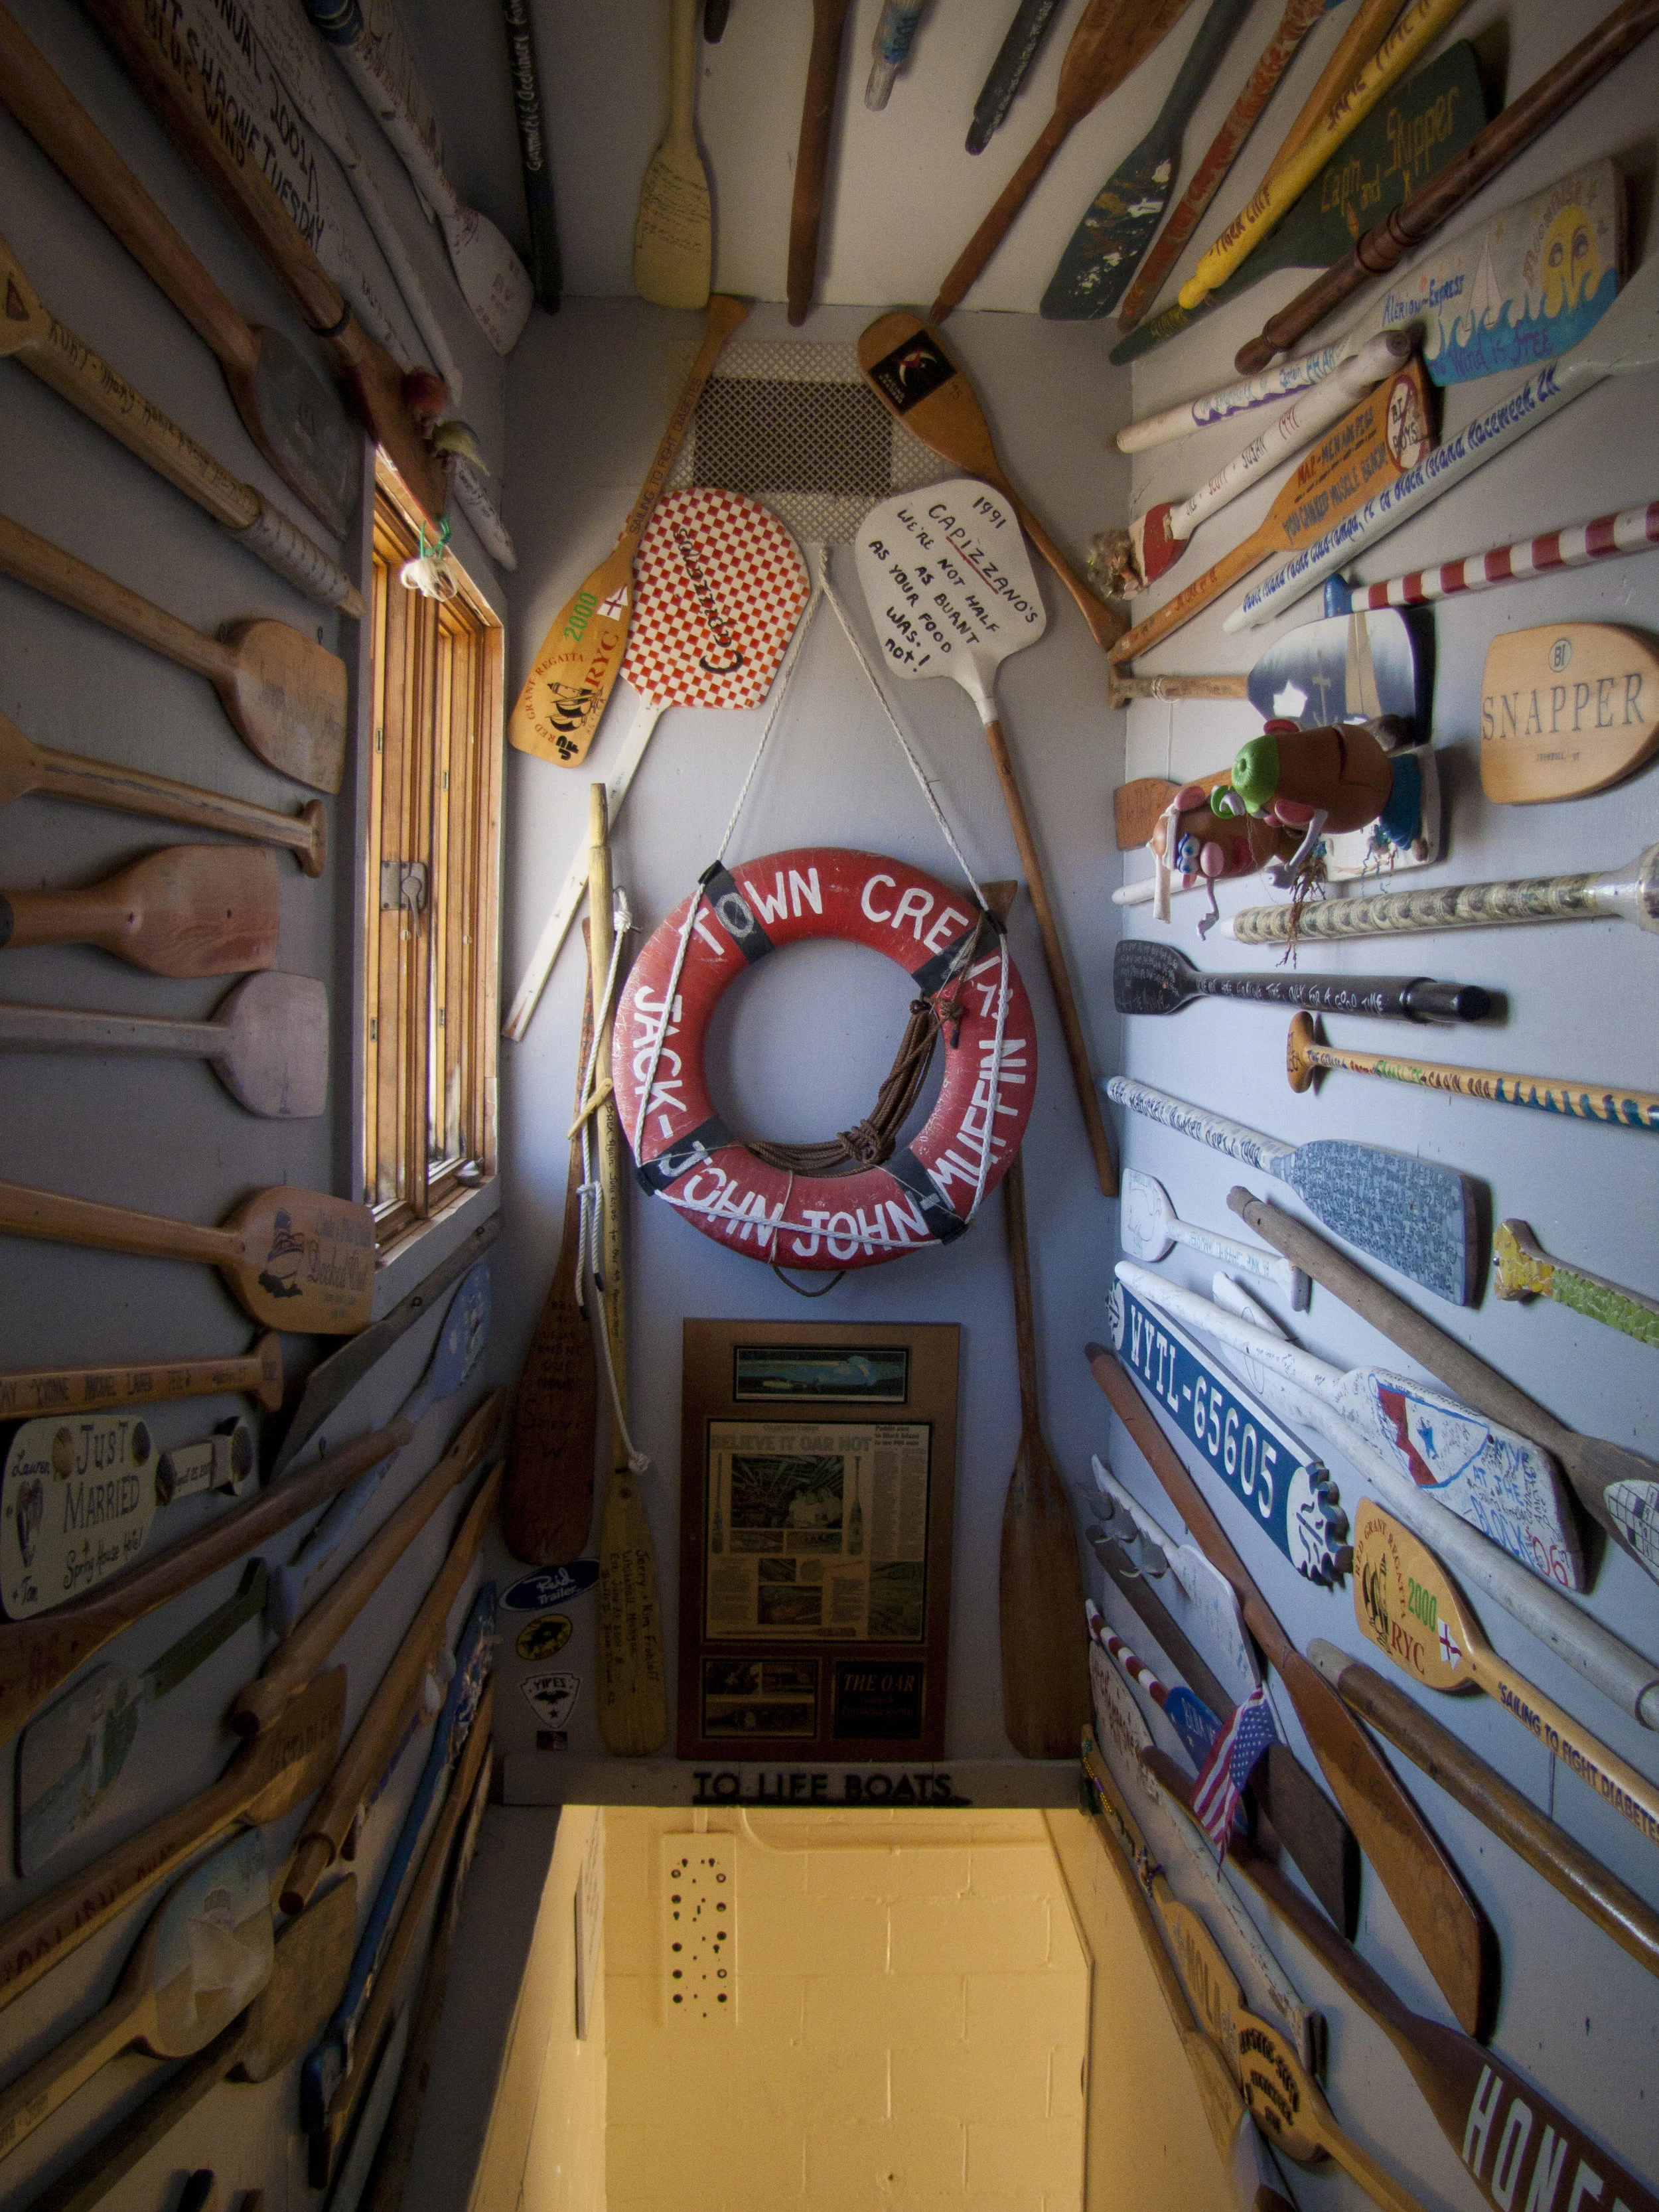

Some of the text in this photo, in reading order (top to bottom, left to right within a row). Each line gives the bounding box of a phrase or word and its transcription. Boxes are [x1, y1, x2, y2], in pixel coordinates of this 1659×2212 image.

[972, 497, 1007, 529] 1991
[914, 566, 935, 587] AS
[928, 503, 1039, 623] CAPIZZANO'S
[563, 591, 599, 643] 2000
[867, 540, 952, 653] AS YOUR FOOD
[937, 557, 966, 586] NOT
[965, 594, 1001, 632] HALF
[534, 652, 585, 677] REGATTA
[584, 630, 618, 688] RYC
[1482, 673, 1644, 741] SNAPPER
[678, 867, 824, 956] TOWN
[631, 985, 687, 1116] JACK
[926, 1037, 1027, 1210] MUFFIN
[658, 1140, 784, 1250] JOHN
[792, 1199, 930, 1260] JOHN
[1131, 1304, 1278, 1519] WYTL-65605
[63, 1475, 141, 1534] MARRIED
[1363, 1517, 1388, 1540] GRANT
[1407, 1576, 1438, 1633] 2000
[1391, 1620, 1426, 1676] RYC
[843, 1673, 916, 1693] THE OAR
[692, 1772, 953, 1801] TO LIFE BOATS
[1544, 1724, 1559, 1752] TO
[1561, 1739, 1599, 1791] FIGHT
[1462, 2063, 1632, 2212] HON
